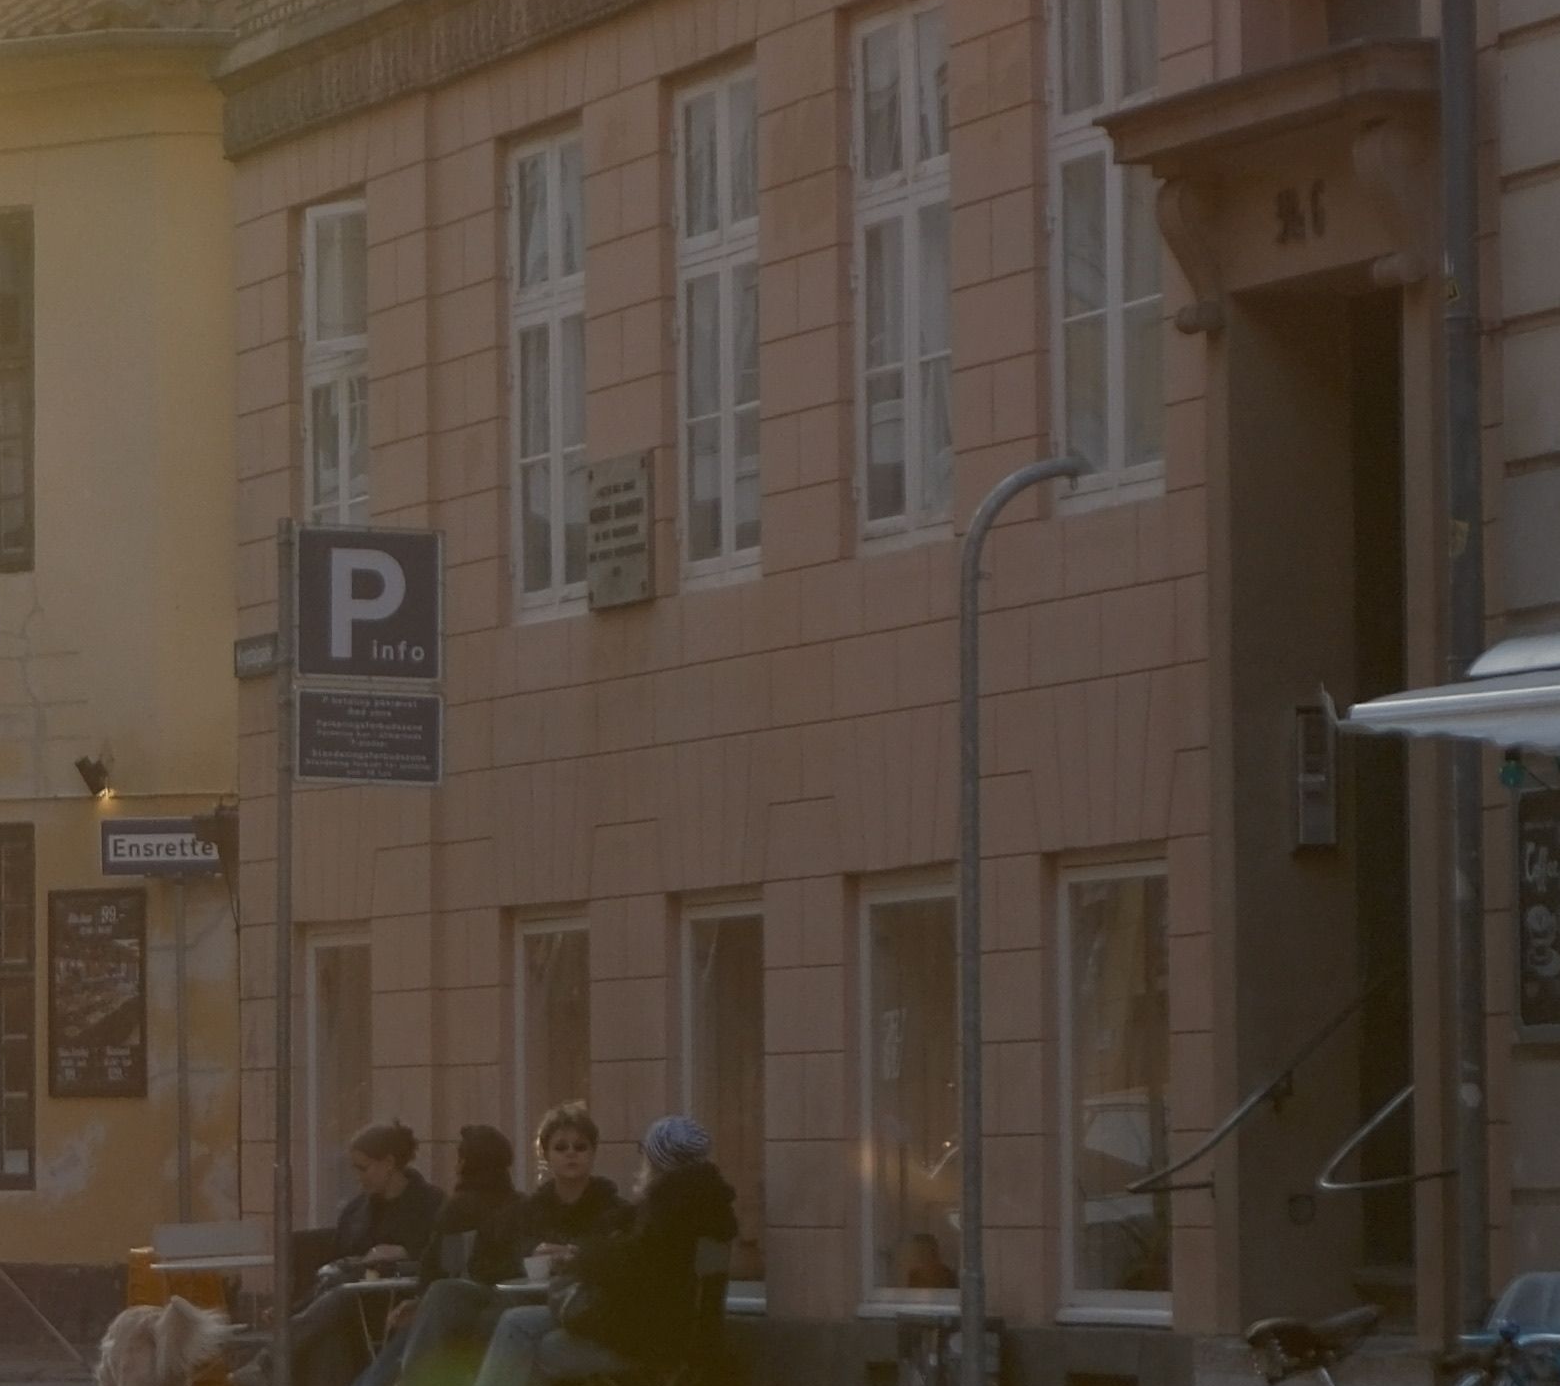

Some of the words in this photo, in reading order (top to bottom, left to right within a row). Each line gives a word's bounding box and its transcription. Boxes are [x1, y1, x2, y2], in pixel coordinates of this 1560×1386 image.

[331, 548, 407, 658] P
[372, 639, 425, 661] info
[112, 837, 215, 858] Ensrette
